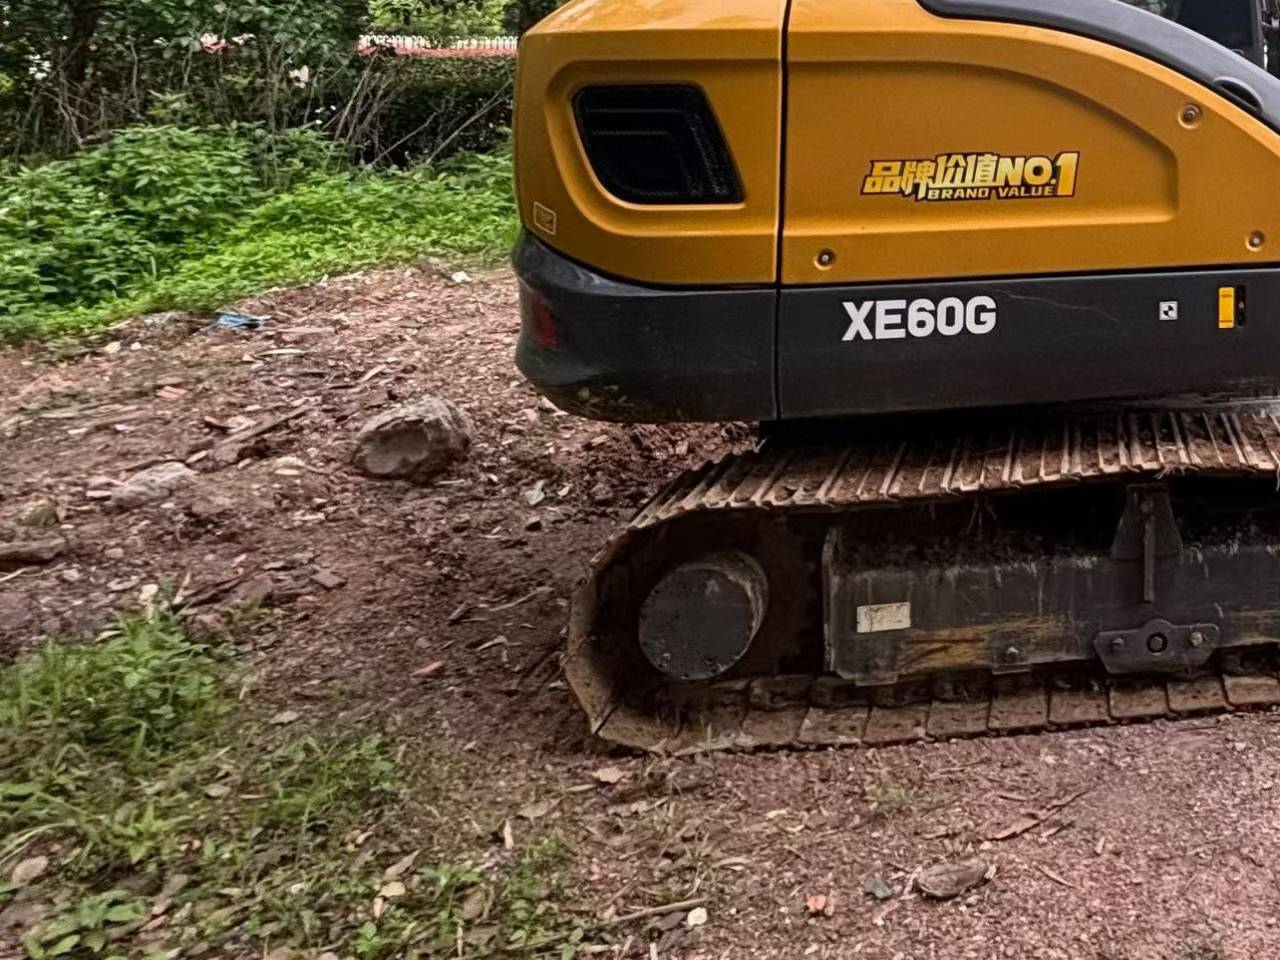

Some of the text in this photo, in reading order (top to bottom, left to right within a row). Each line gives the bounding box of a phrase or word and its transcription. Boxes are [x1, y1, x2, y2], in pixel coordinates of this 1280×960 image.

[928, 186, 1055, 199] BRAND VALUE
[842, 296, 997, 341] XE60G
